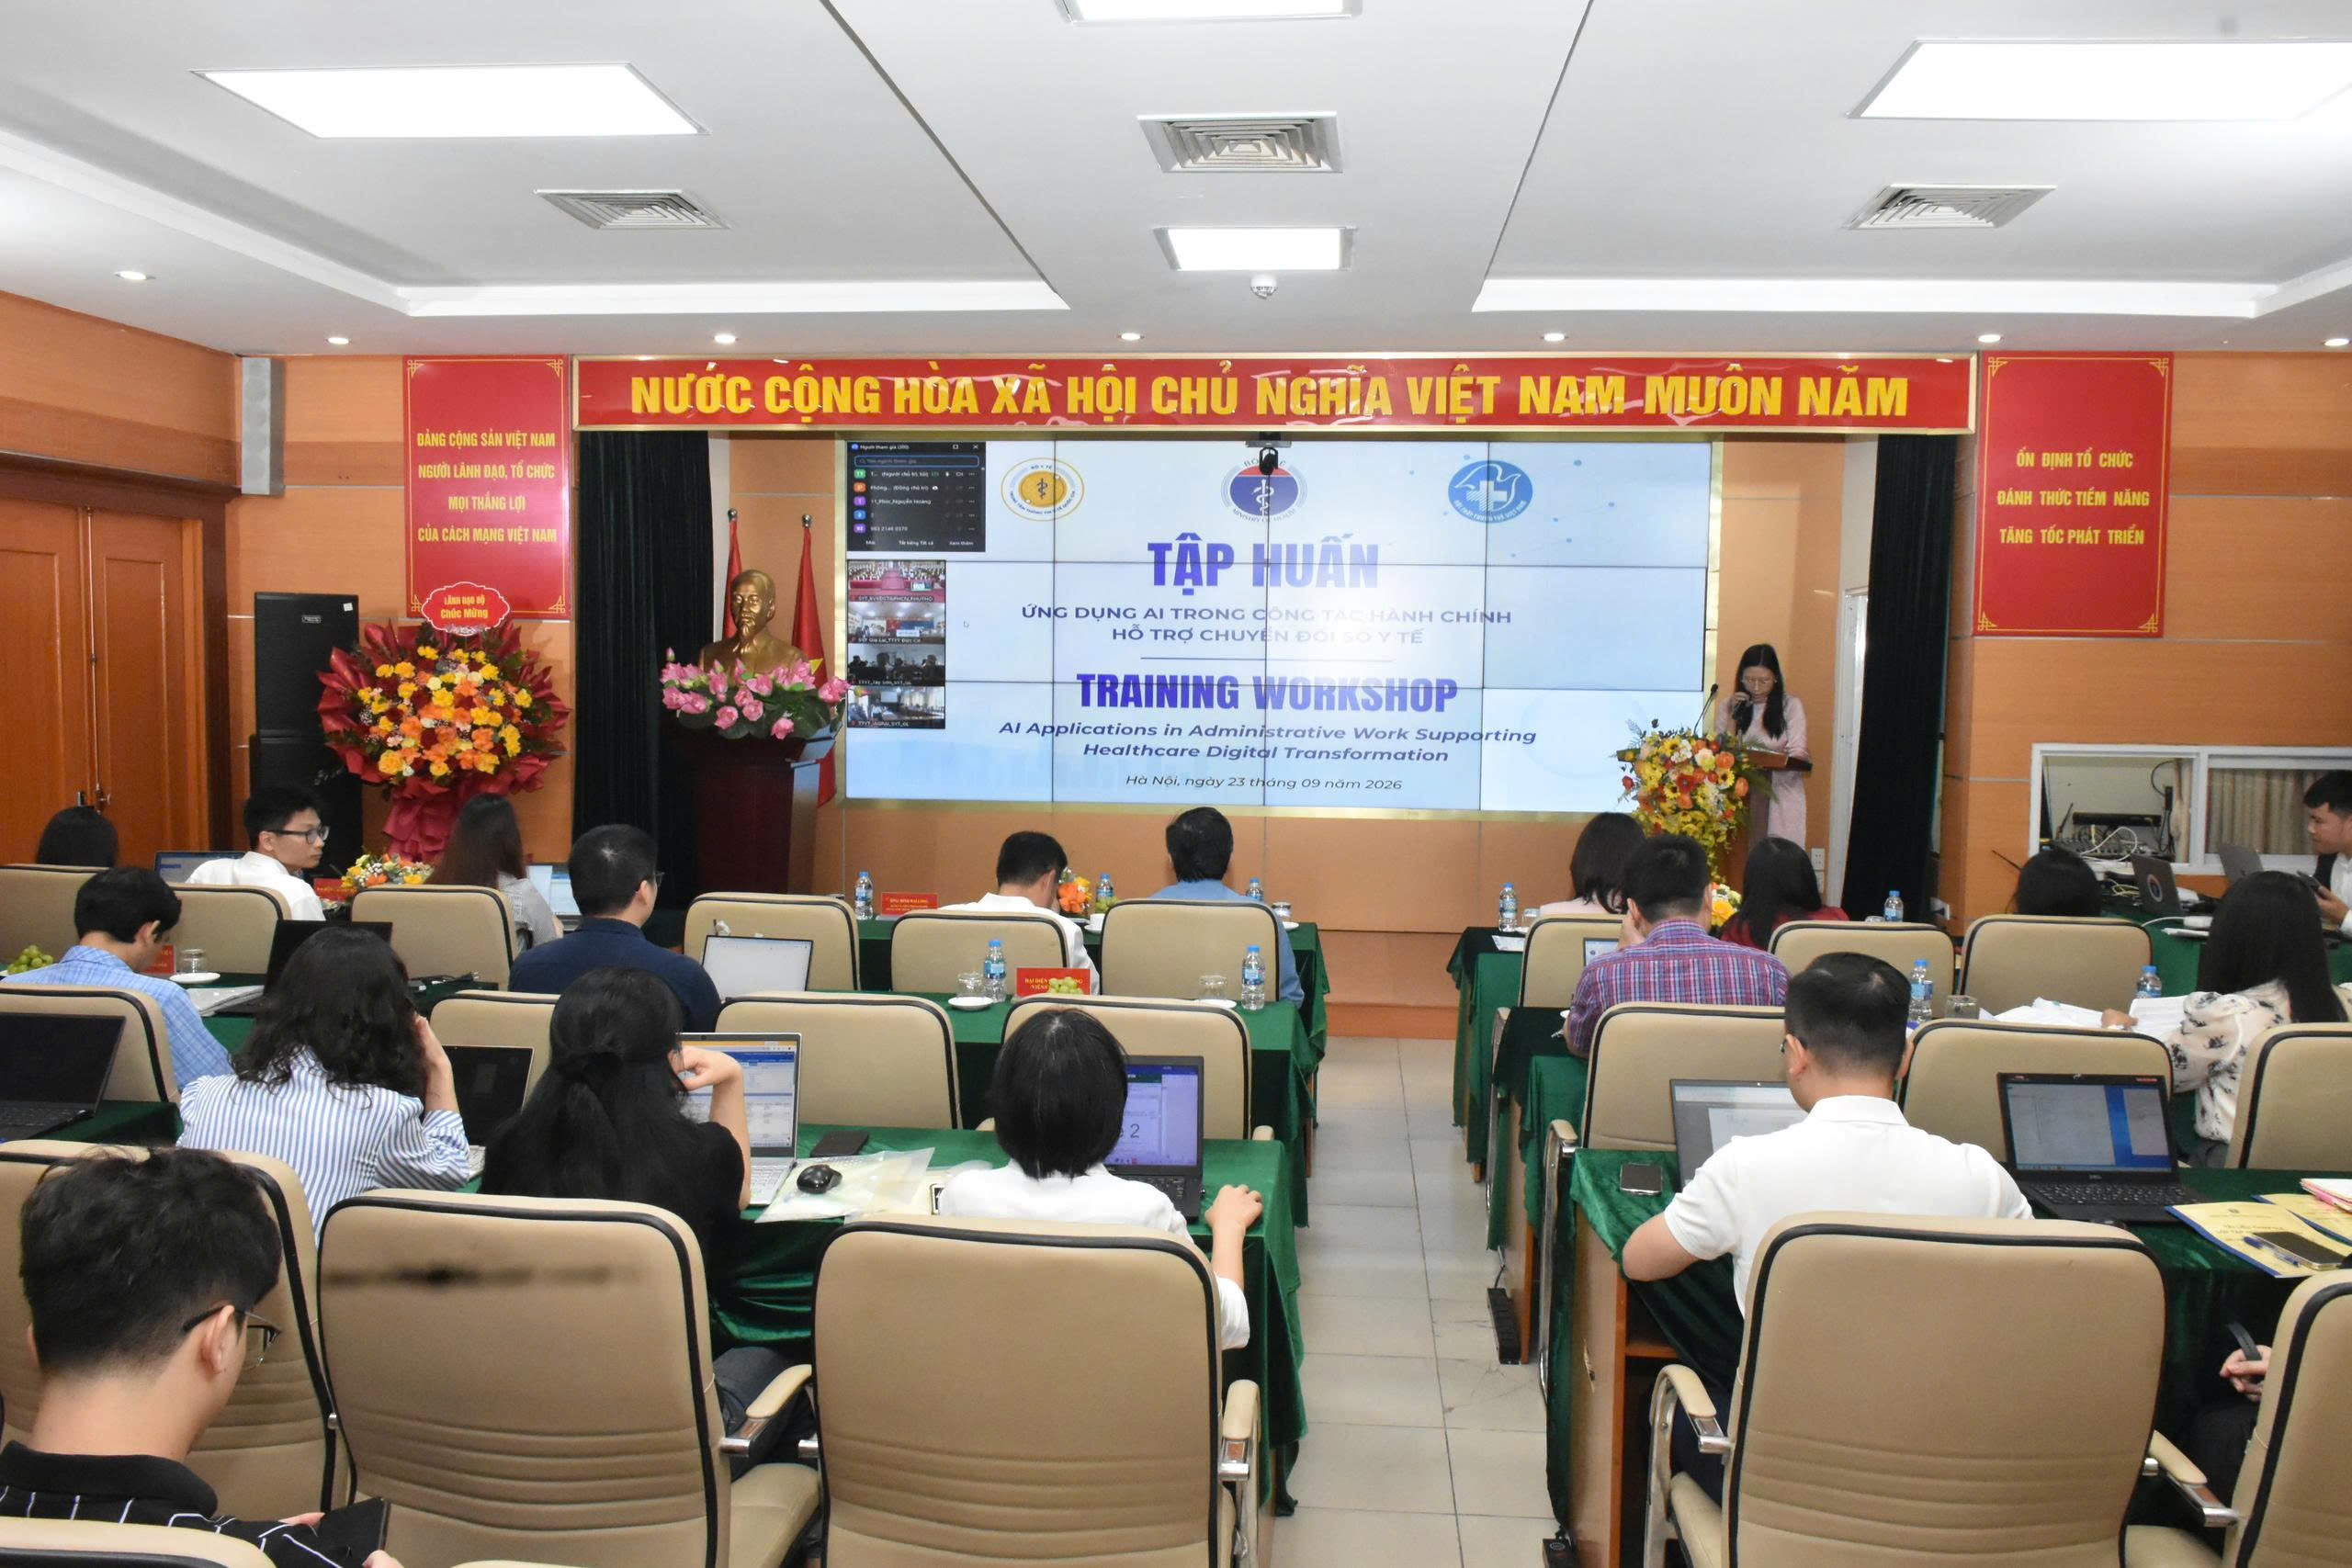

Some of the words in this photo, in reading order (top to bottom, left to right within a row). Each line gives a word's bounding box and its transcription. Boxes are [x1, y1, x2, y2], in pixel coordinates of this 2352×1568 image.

[631, 362, 755, 414] NƯỚC
[764, 364, 882, 423] CỘNG
[893, 361, 982, 414] HÒA
[991, 363, 1051, 414] XÃ
[1067, 364, 1136, 423] HỘI
[1151, 360, 1238, 415] CHỦ
[1256, 364, 1393, 415] NGHĨA
[1407, 364, 1501, 423] VIỆT
[1519, 376, 1625, 415] NAM
[1645, 364, 1783, 416] MUÔN
[1798, 365, 1908, 416] NĂM
[417, 428, 447, 446] ĐẢNG
[448, 429, 478, 450] CỘNG
[481, 428, 503, 446] SẢN
[505, 429, 527, 450] VIỆT
[530, 433, 556, 446] NAM
[2016, 446, 2035, 468] ỔN
[2041, 451, 2074, 470] ĐỊNH
[2098, 449, 2133, 468] CHỨC
[418, 461, 450, 479] NGƯỜI
[453, 461, 481, 479] LÃNH
[511, 459, 524, 479] TỔ
[526, 461, 555, 479] CHỨC
[447, 495, 469, 513] MỌI
[471, 491, 506, 511] THẮNG
[509, 495, 526, 513] LỢI
[1996, 488, 2032, 505] ĐÁNH
[2040, 488, 2073, 506] THỨC
[2113, 488, 2150, 507] NĂNG
[418, 523, 439, 542] CỦA
[441, 525, 470, 542] CÁCH
[473, 527, 504, 545] MẠNG
[507, 525, 529, 545] VIỆT
[532, 528, 557, 542] NAM
[2000, 525, 2033, 544] TĂNG
[2041, 524, 2064, 544] TỐC
[2067, 525, 2100, 545] PHÁT
[1148, 532, 1235, 595] TẬP
[1252, 533, 1379, 588] HUẤN
[441, 608, 462, 618] Chúc
[464, 608, 489, 619] Mừng
[1022, 604, 1068, 618] ỨNG
[1075, 607, 1136, 622] DỤNG
[1143, 607, 1164, 619] AI
[1170, 607, 1246, 620] TRONG
[1252, 605, 1315, 621] CÔNG
[1370, 606, 1433, 623] HÀNH
[1441, 608, 1511, 623] CHÍNH
[1113, 624, 1144, 640] HỖ
[1149, 628, 1194, 644] TRỢ
[1396, 627, 1425, 644] TẾ
[1077, 673, 1239, 709] TRAINING
[1252, 675, 1457, 713] WORKSHOP
[1000, 722, 1021, 734] AI
[1026, 721, 1158, 738] Applications
[1163, 723, 1183, 736] in
[1189, 724, 1346, 739] Administrative
[1353, 727, 1409, 740] Work
[1416, 728, 1537, 745] Supporting
[1083, 743, 1200, 757] Healthcare
[1206, 745, 1277, 761] Digital
[1284, 747, 1449, 761] Transformation
[1125, 775, 1148, 785] Hà
[1152, 776, 1181, 787] Nội,
[1185, 777, 1224, 788] ngày
[1227, 777, 1245, 787] 23
[1250, 777, 1296, 790] tháng
[1302, 778, 1320, 788] 09
[1325, 779, 1361, 789] năm
[1365, 780, 1402, 790] 2026
